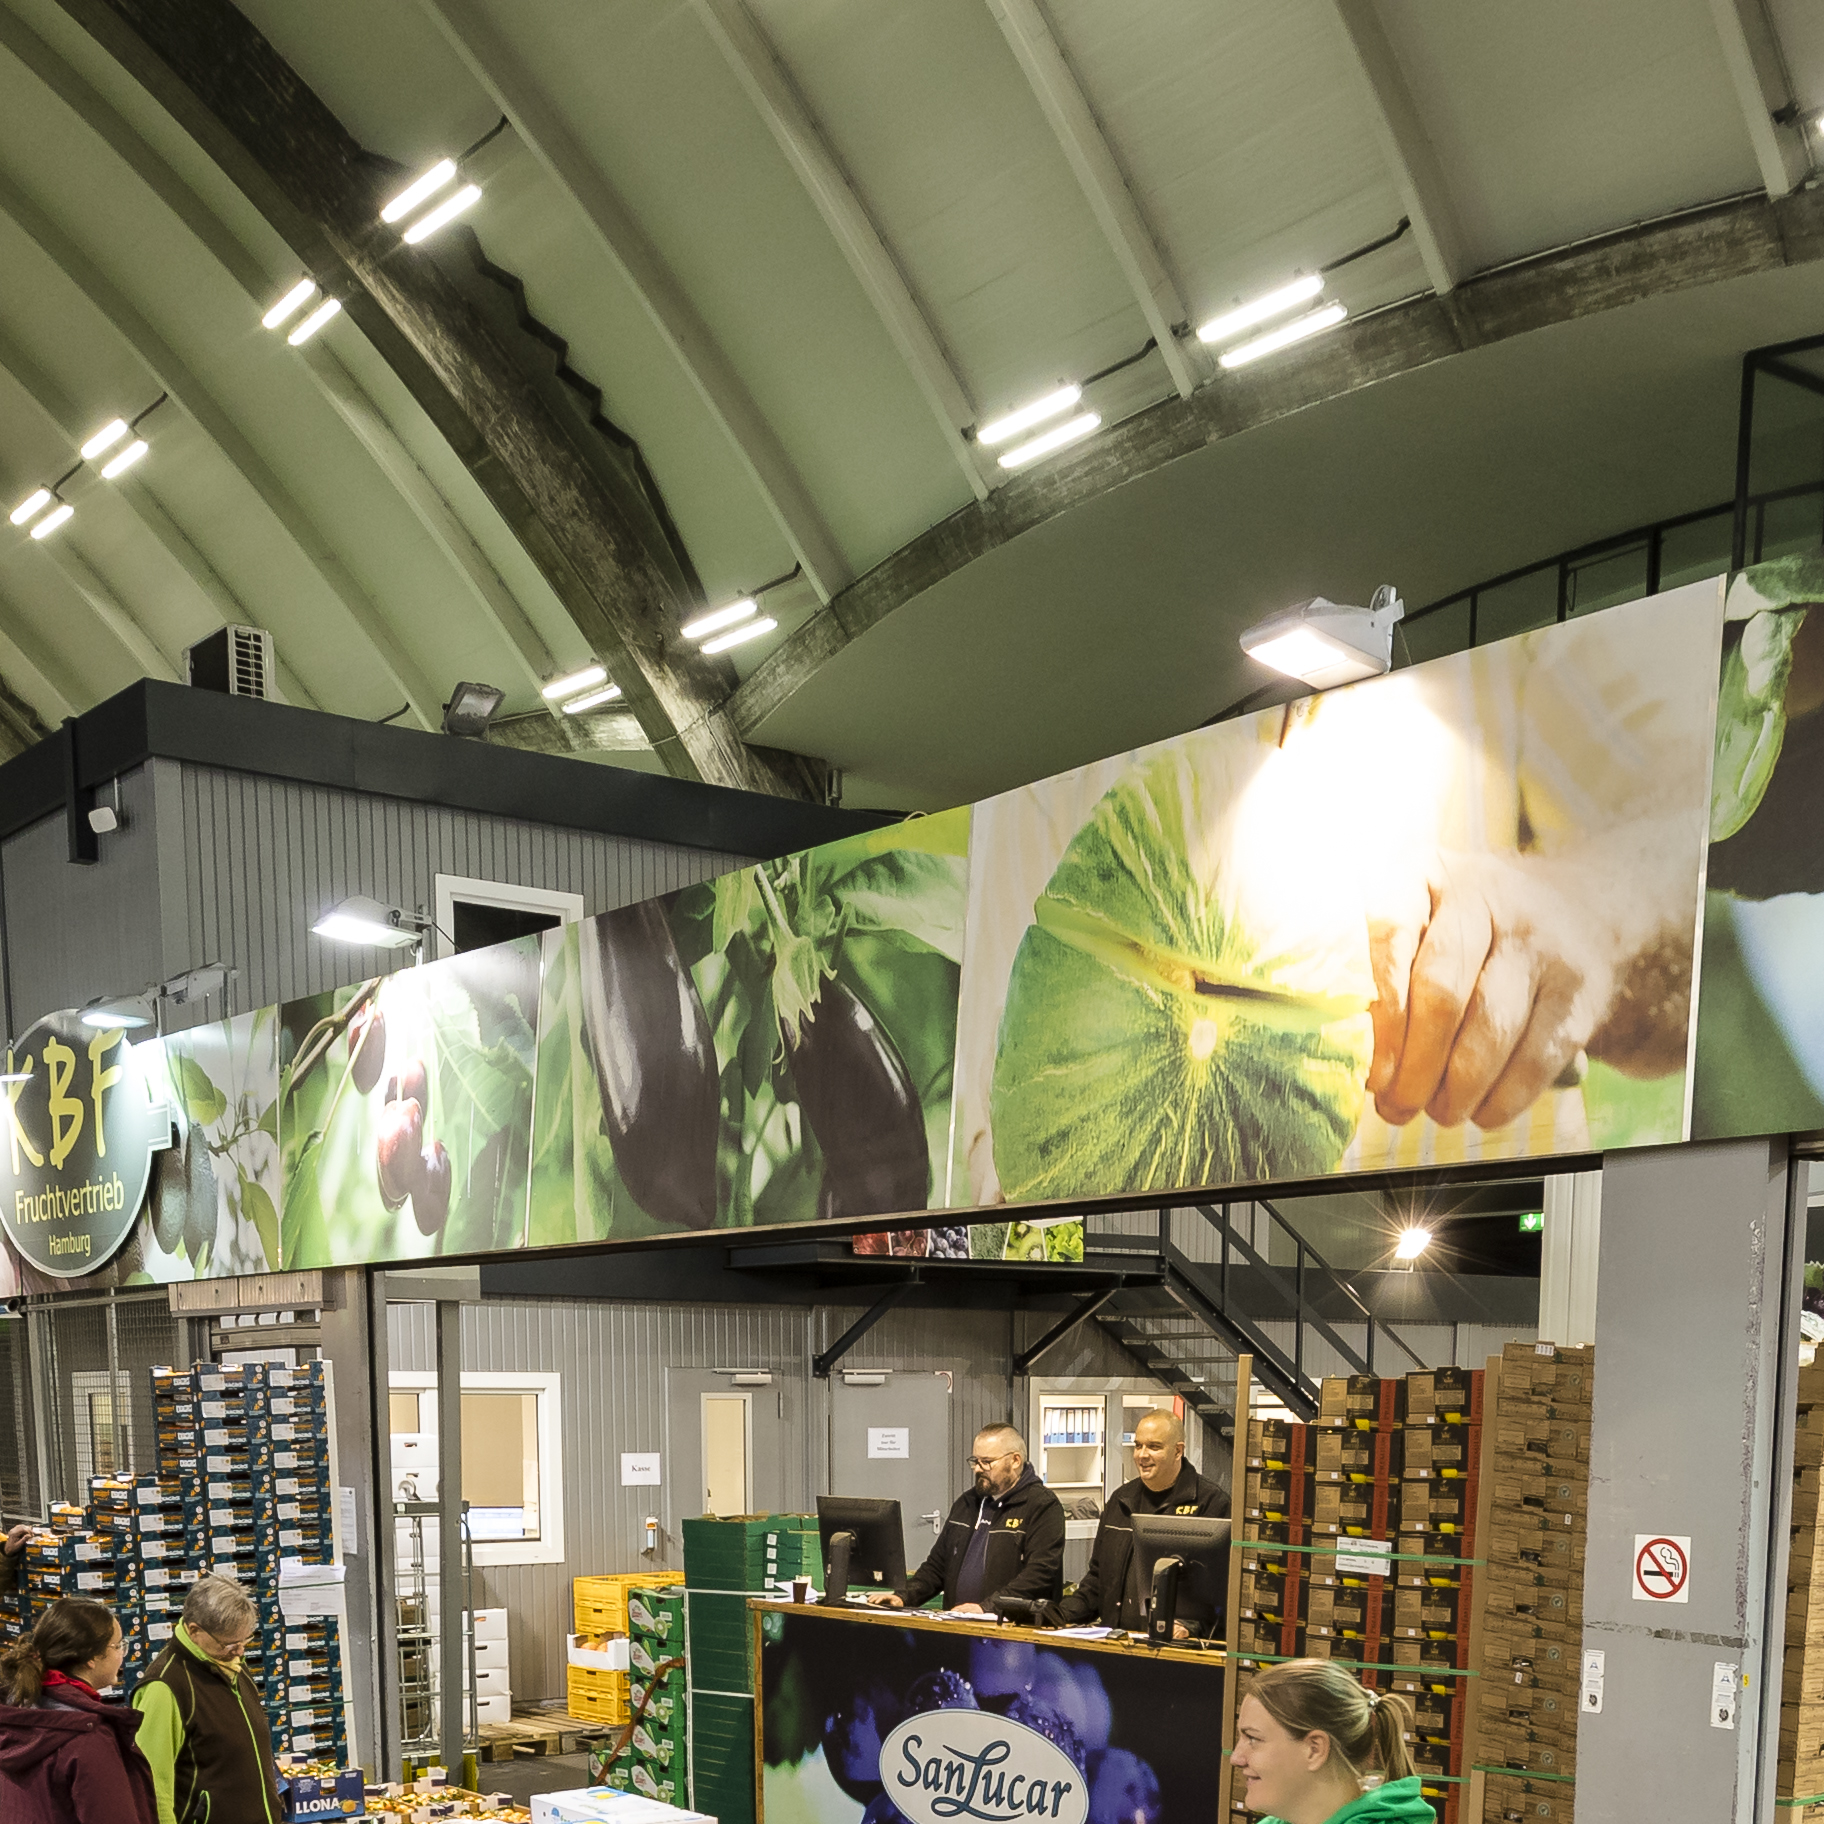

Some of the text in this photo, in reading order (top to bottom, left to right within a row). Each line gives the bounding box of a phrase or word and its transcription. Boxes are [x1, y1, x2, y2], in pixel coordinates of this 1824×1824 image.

[15, 1172, 124, 1226] Fruchtvertrieb
[48, 1233, 91, 1257] Hamburg
[631, 1464, 651, 1472] Kasse
[897, 1734, 1071, 1821] SanLucar
[295, 1798, 340, 1814] LLONA
